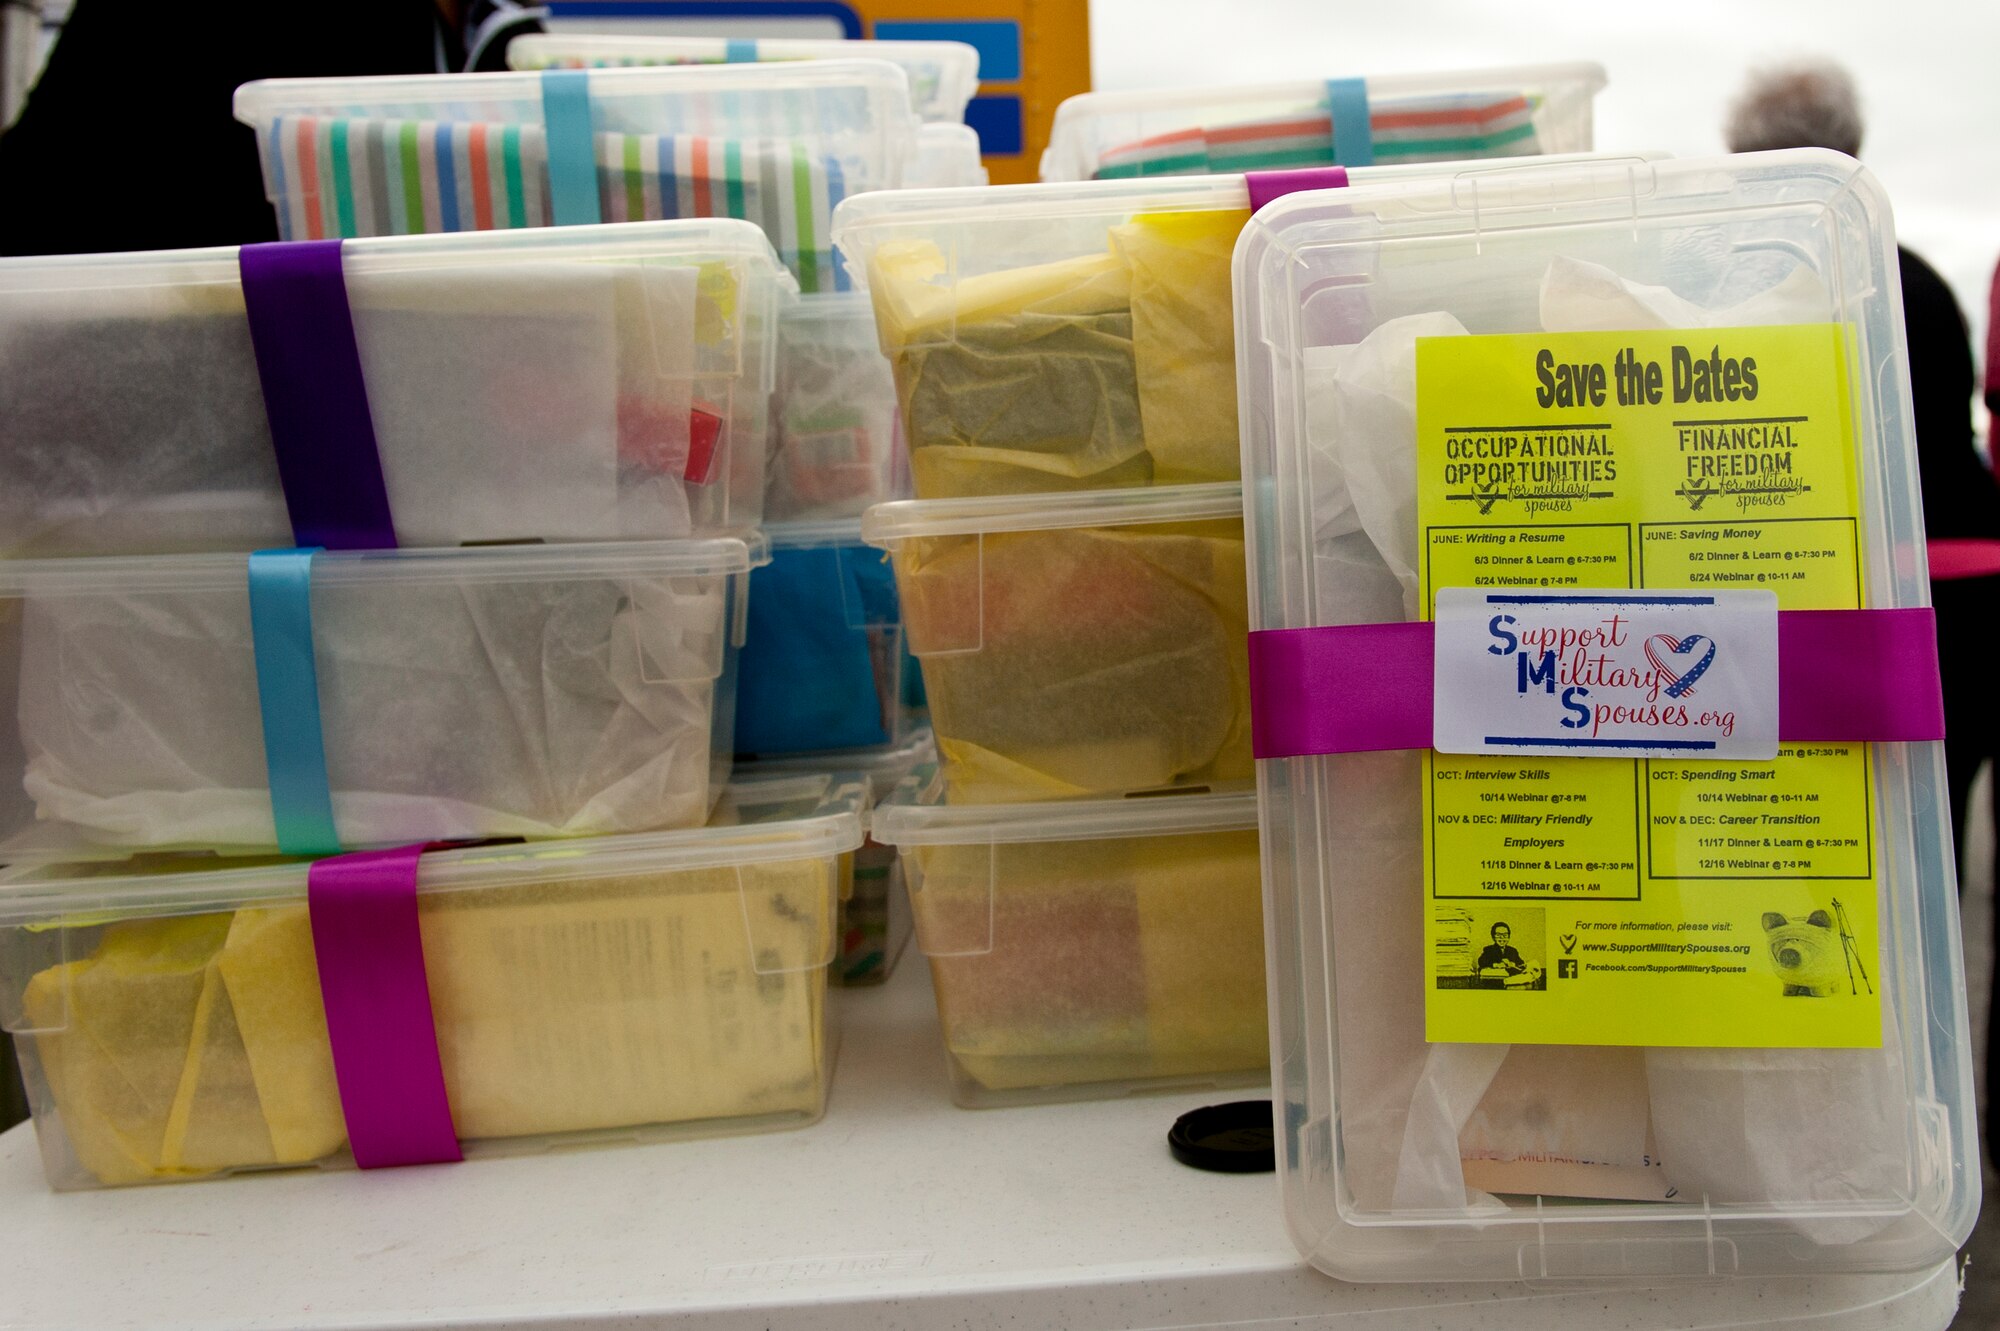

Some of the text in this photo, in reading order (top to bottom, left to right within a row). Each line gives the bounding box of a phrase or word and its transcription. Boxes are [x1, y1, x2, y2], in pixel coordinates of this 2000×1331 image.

[1536, 345, 1759, 409] Save the Dates
[1680, 426, 1798, 451] FINANCIAL
[1447, 435, 1614, 459] OCCUPATIONAL
[1687, 452, 1792, 477] FREEDOM
[1445, 460, 1616, 484] OPPORTUNITIES
[1508, 473, 1589, 502] for military
[1720, 467, 1803, 497] for military
[1525, 499, 1572, 519] spouses
[1736, 493, 1786, 514] spouses
[1432, 532, 1566, 545] JUNE: Writing a Resume
[1645, 528, 1762, 541] JUNE: Saving Money
[1474, 555, 1617, 566] 6/3 Dinner & Learn @ 6-7:30 PM
[1688, 550, 1836, 561] 6/2 Dinner & Learn @ 6-7:30 PM
[1474, 576, 1578, 587] 6/24 Webinar @ 7-8 PM
[1689, 572, 1806, 583] 6/24 Webinar @ 10-11 AM
[1488, 614, 1629, 660] Support
[1517, 648, 1661, 701] Military
[1560, 686, 1735, 737] Spouses.org
[1795, 749, 1806, 759] @
[1806, 748, 1833, 758] 6-7:30
[1834, 748, 1849, 757] PM
[1436, 769, 1551, 780] OCT: Interview Skills
[1651, 769, 1776, 782] OCT: Spending Smart
[1479, 793, 1506, 802] 10/14
[1506, 792, 1549, 802] Webinar
[1573, 794, 1587, 802] PM
[1696, 793, 1820, 804] 10/14 Webinar @ 10-11 AM
[1437, 814, 1594, 827] NOV & DEC: Military Friendly
[1653, 814, 1821, 825] NOV & DEC: Career Transition
[1503, 837, 1566, 850] Employers
[1698, 838, 1859, 849] 11/17 Dinner & Learn @ 6-7:30 PM
[1480, 860, 1507, 870] 11/18
[1509, 860, 1542, 870] Dinner
[1543, 860, 1552, 870] &
[1554, 860, 1584, 870] Learn
[1620, 862, 1634, 870] PM
[1698, 859, 1812, 870] 12/16 Webinar @ 7-8 PM
[1480, 881, 1601, 893] 12/16 Webinar @ 10-11 AM
[1575, 920, 1734, 933] For more information, please visit:
[1582, 942, 1751, 955] www.SupportMilitarySpouses.org
[1585, 963, 1748, 974] Facebook.com/SupportMilitarySpouses
